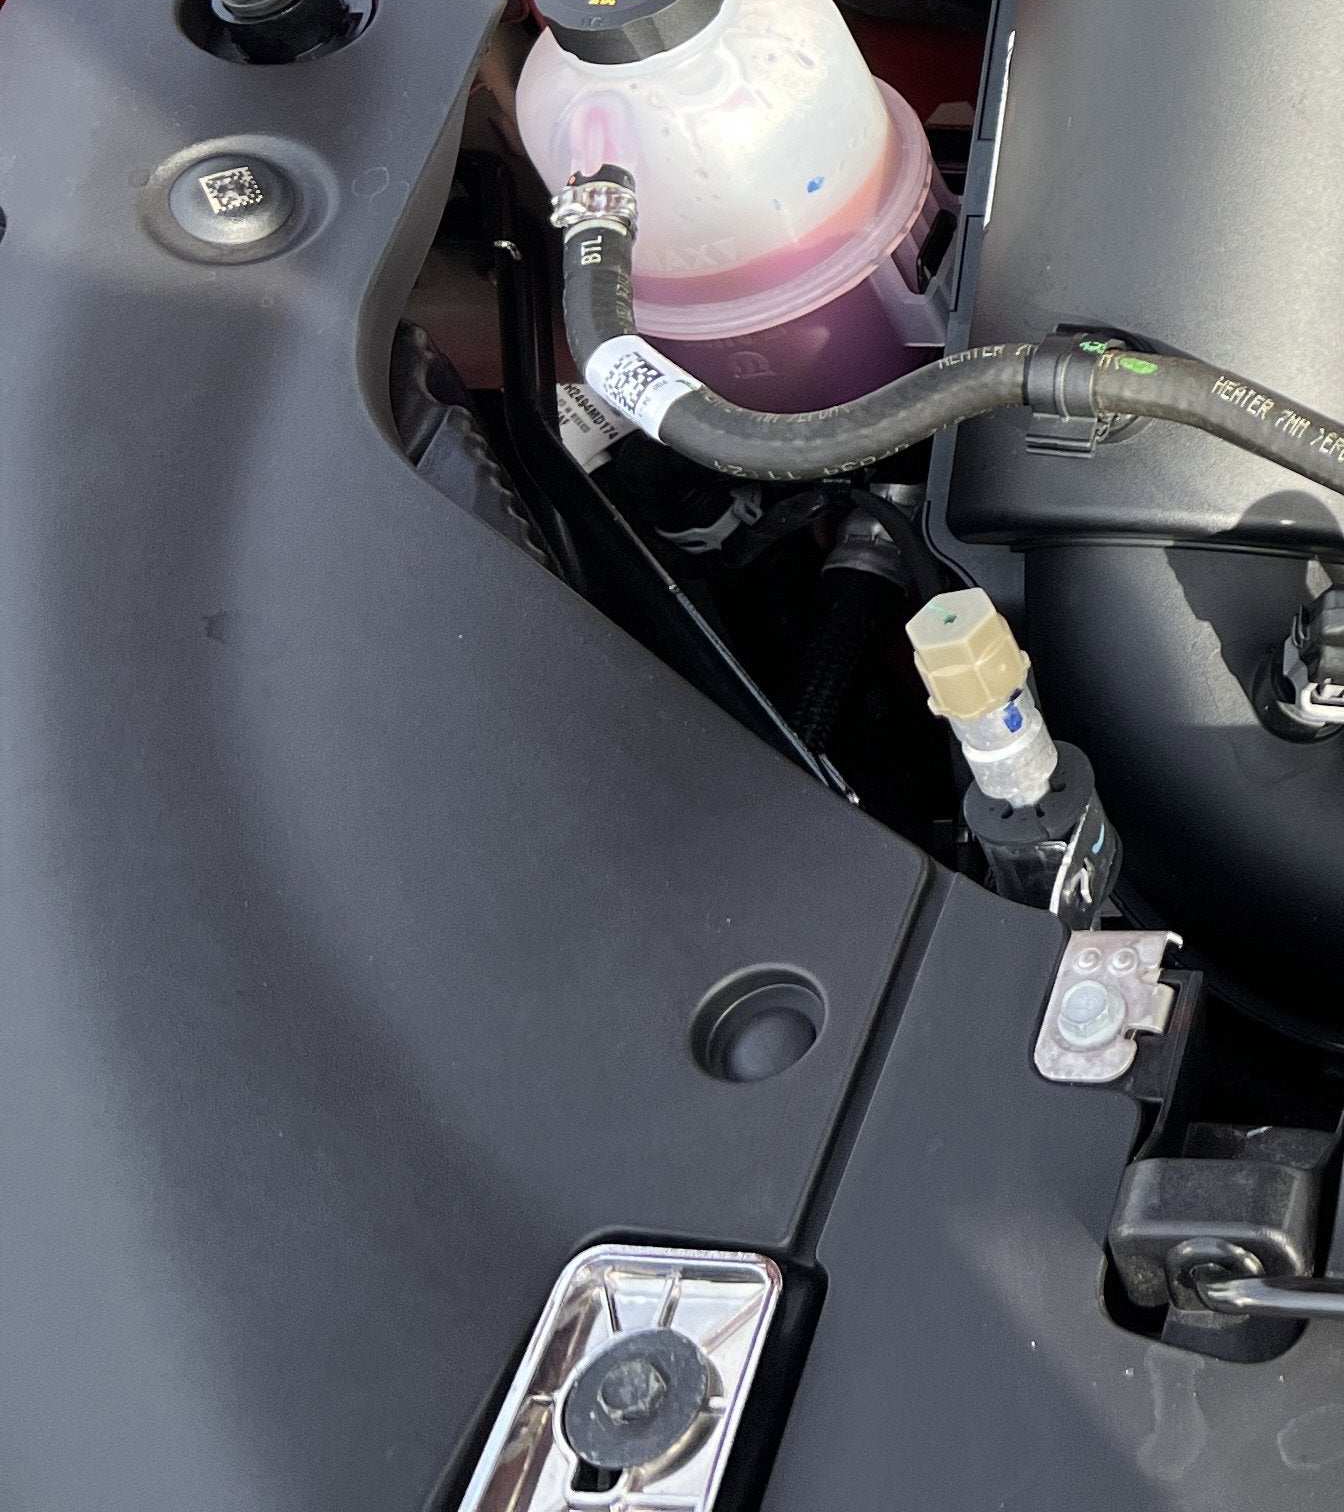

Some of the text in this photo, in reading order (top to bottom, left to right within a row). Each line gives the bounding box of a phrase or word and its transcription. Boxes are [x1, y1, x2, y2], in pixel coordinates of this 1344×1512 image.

[581, 234, 602, 266] BTL
[1211, 375, 1275, 420] HEATER
[1274, 408, 1311, 440] 7MM
